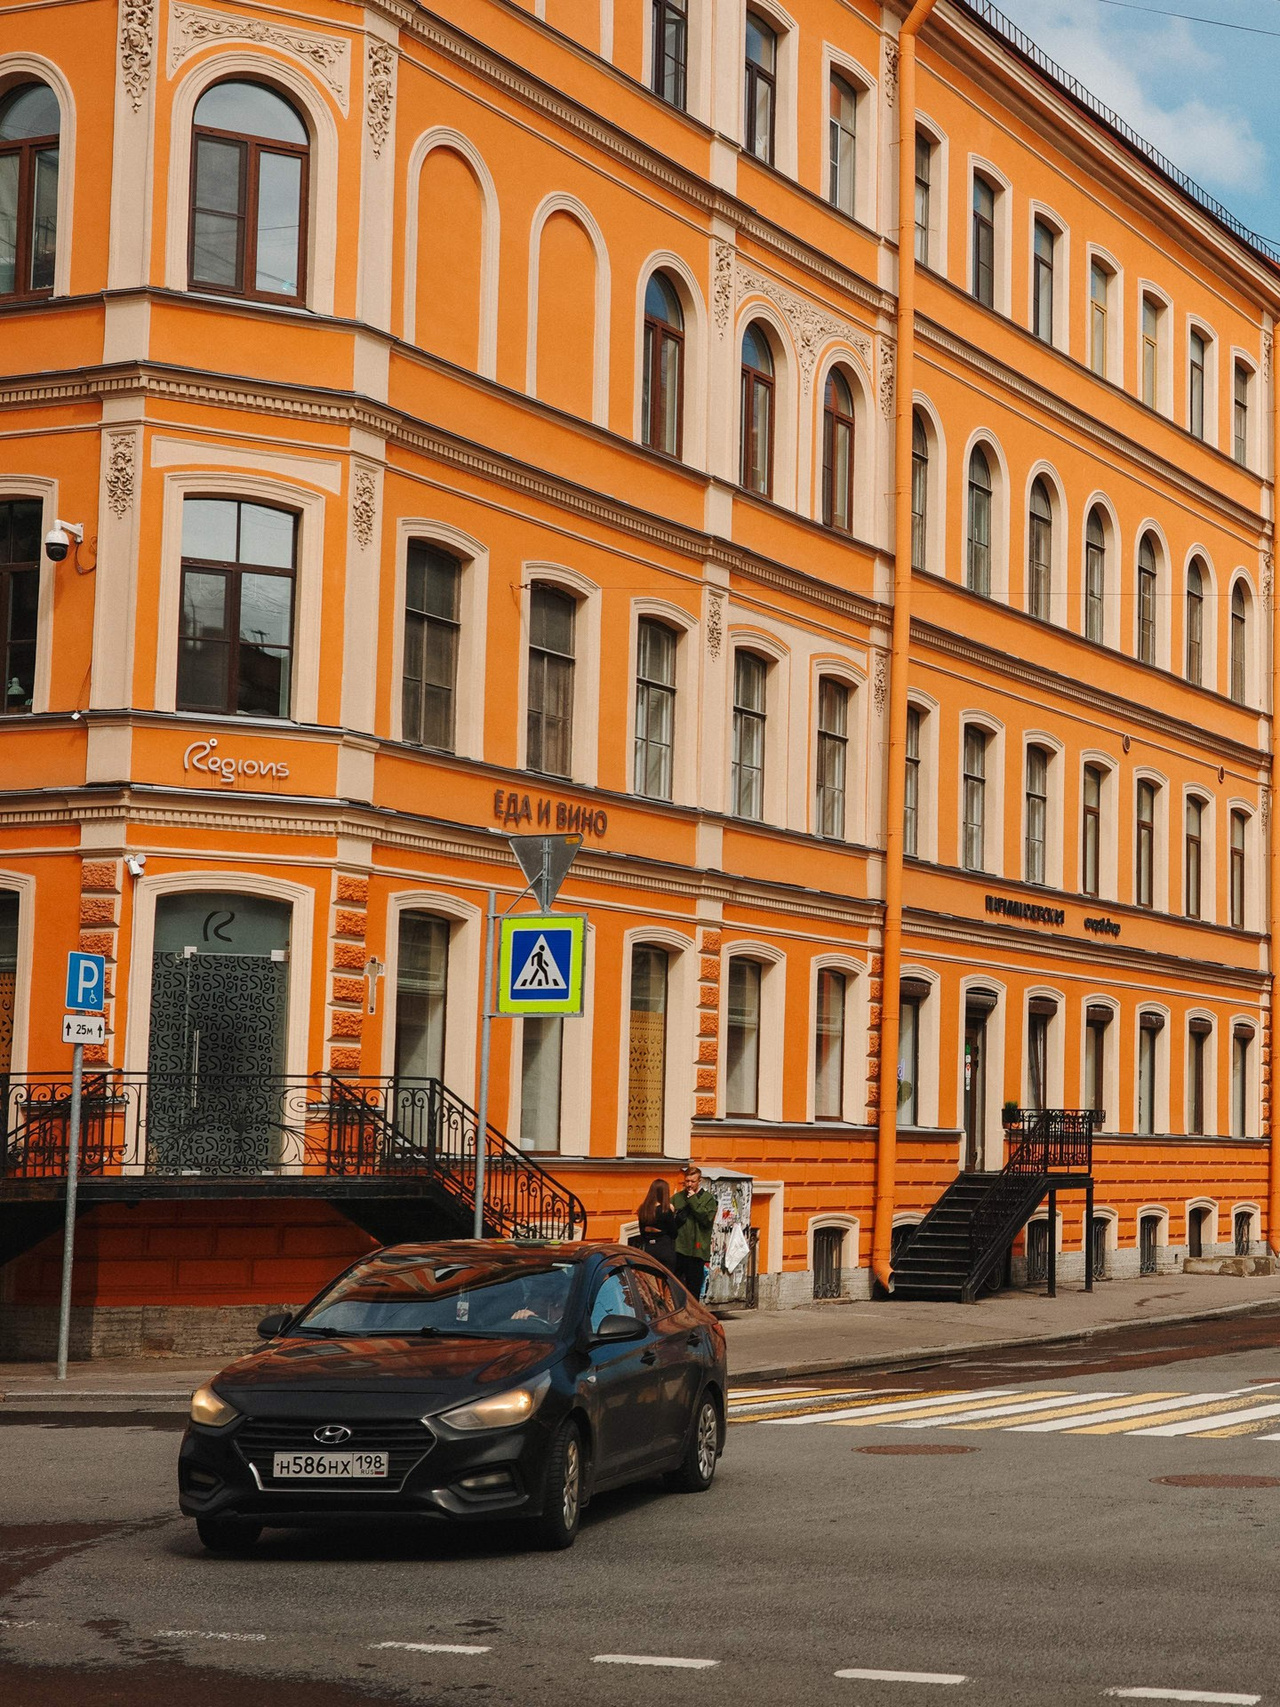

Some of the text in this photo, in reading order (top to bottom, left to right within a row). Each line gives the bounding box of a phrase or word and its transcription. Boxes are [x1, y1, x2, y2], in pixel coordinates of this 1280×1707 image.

[184, 738, 290, 783] Regions
[493, 789, 608, 836] ЕДА И ВИНО
[78, 959, 99, 1003] P
[355, 1455, 382, 1470] 198
